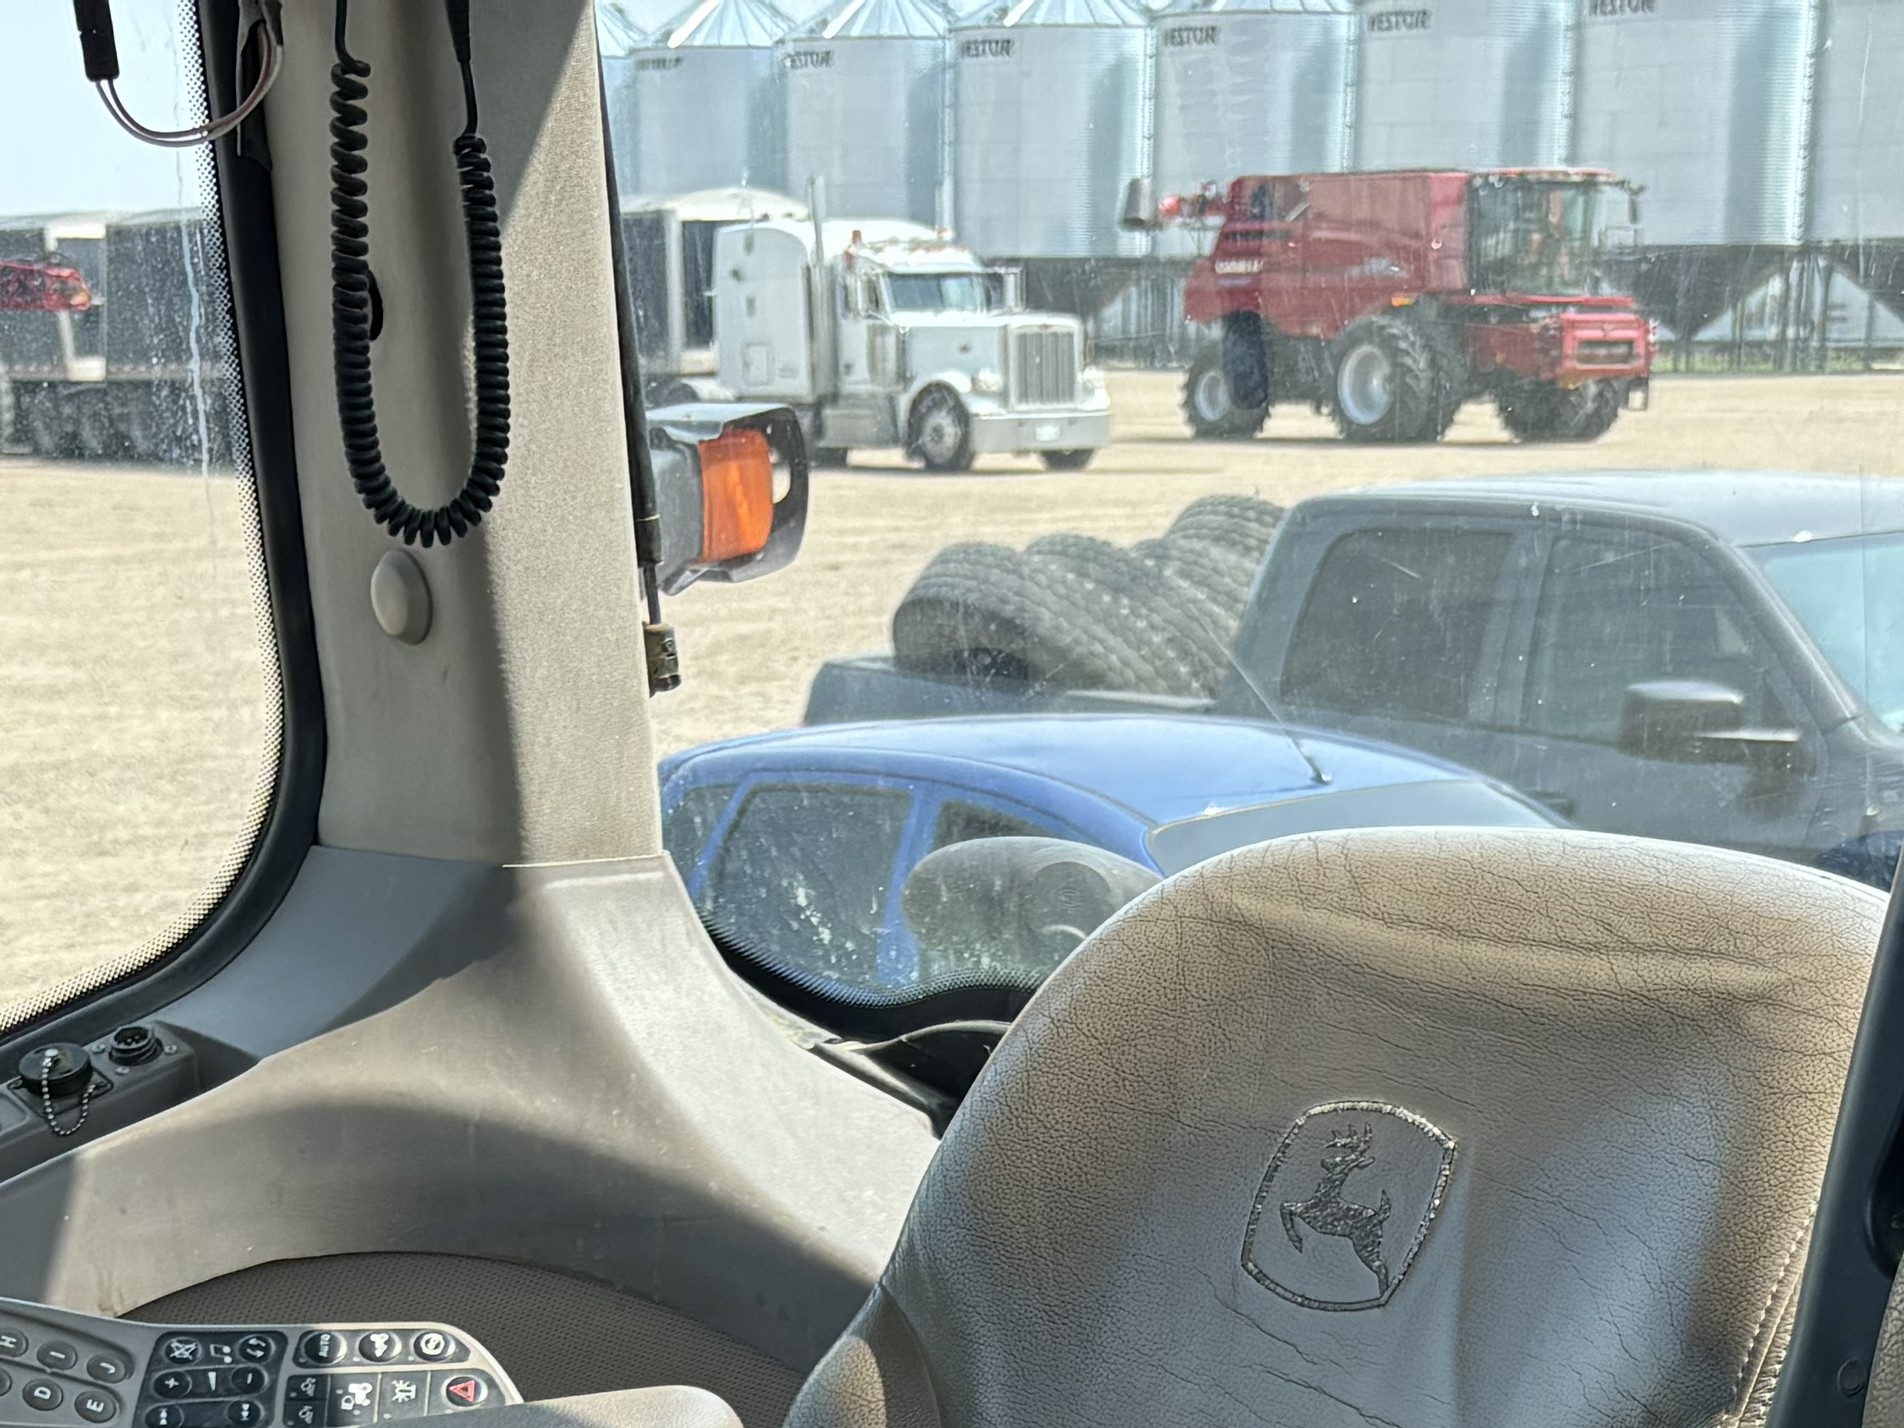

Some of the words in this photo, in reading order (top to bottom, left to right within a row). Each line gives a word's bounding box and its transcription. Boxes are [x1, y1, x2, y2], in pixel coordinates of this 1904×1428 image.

[0, 1334, 17, 1348] H
[318, 1333, 331, 1358] AUTO
[99, 1362, 117, 1374] J
[33, 1386, 52, 1400] D
[86, 1399, 104, 1413] E
